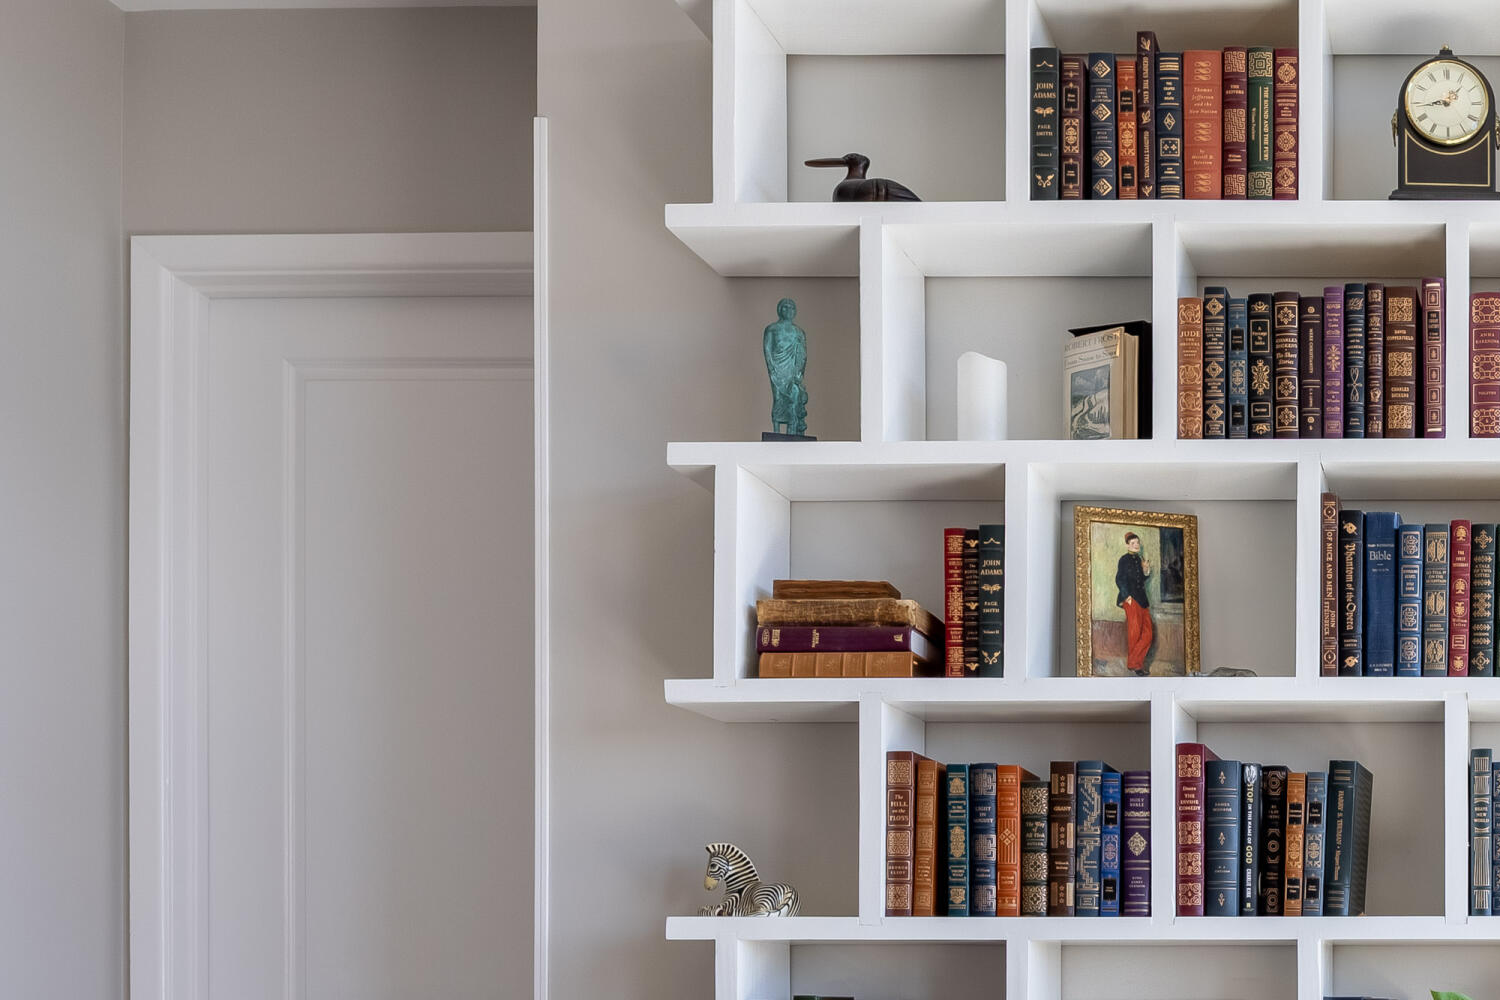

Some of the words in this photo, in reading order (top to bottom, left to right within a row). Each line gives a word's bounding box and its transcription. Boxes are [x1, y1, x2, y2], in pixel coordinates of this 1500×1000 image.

[1036, 82, 1054, 90] JOHN
[1180, 330, 1201, 338] JUDE
[1326, 531, 1333, 542] OF
[1369, 550, 1391, 561] Bible
[1344, 543, 1356, 582] Phantom
[1346, 592, 1355, 602] the
[1344, 602, 1357, 630] Opera
[1246, 783, 1254, 803] STOP
[1245, 845, 1253, 864] GOD
